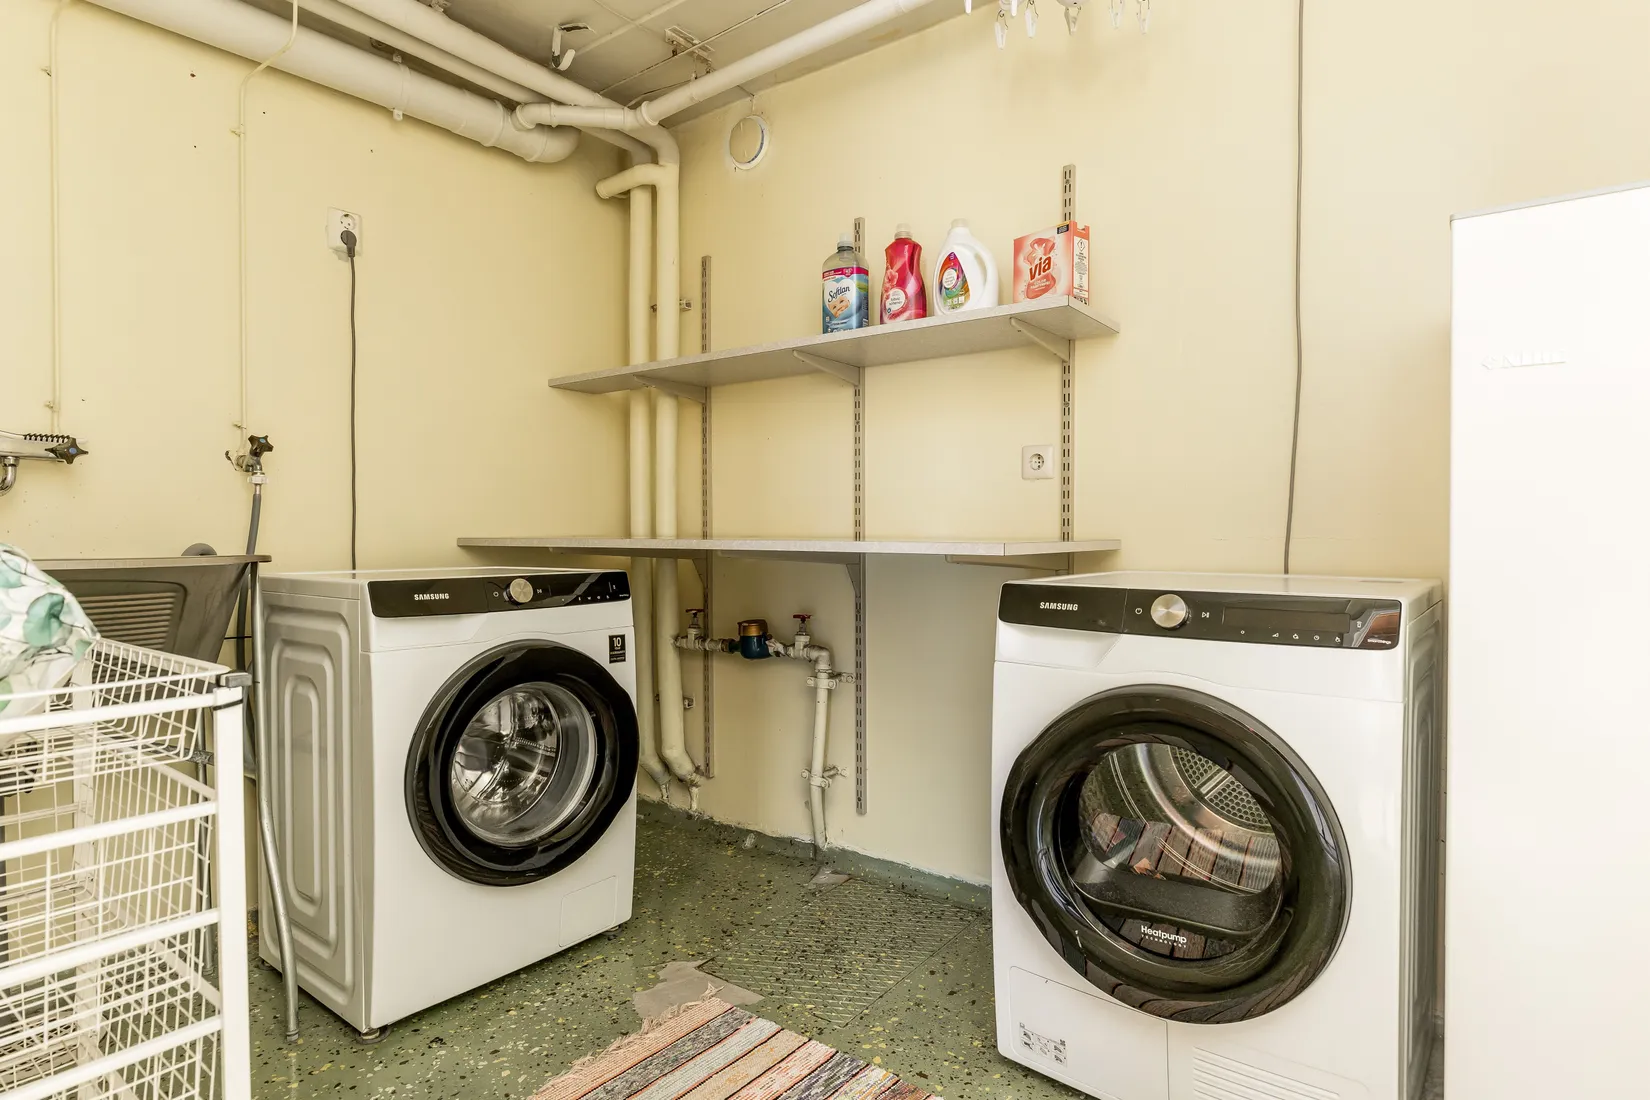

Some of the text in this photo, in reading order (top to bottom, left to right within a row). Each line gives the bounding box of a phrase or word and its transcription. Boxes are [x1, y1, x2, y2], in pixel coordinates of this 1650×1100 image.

[1029, 256, 1051, 281] via
[827, 286, 850, 303] Softlan
[413, 593, 450, 601] SAMSUNG
[1039, 601, 1079, 611] SAMSUNG
[612, 637, 621, 647] 10
[1141, 925, 1187, 944] Heatpump
